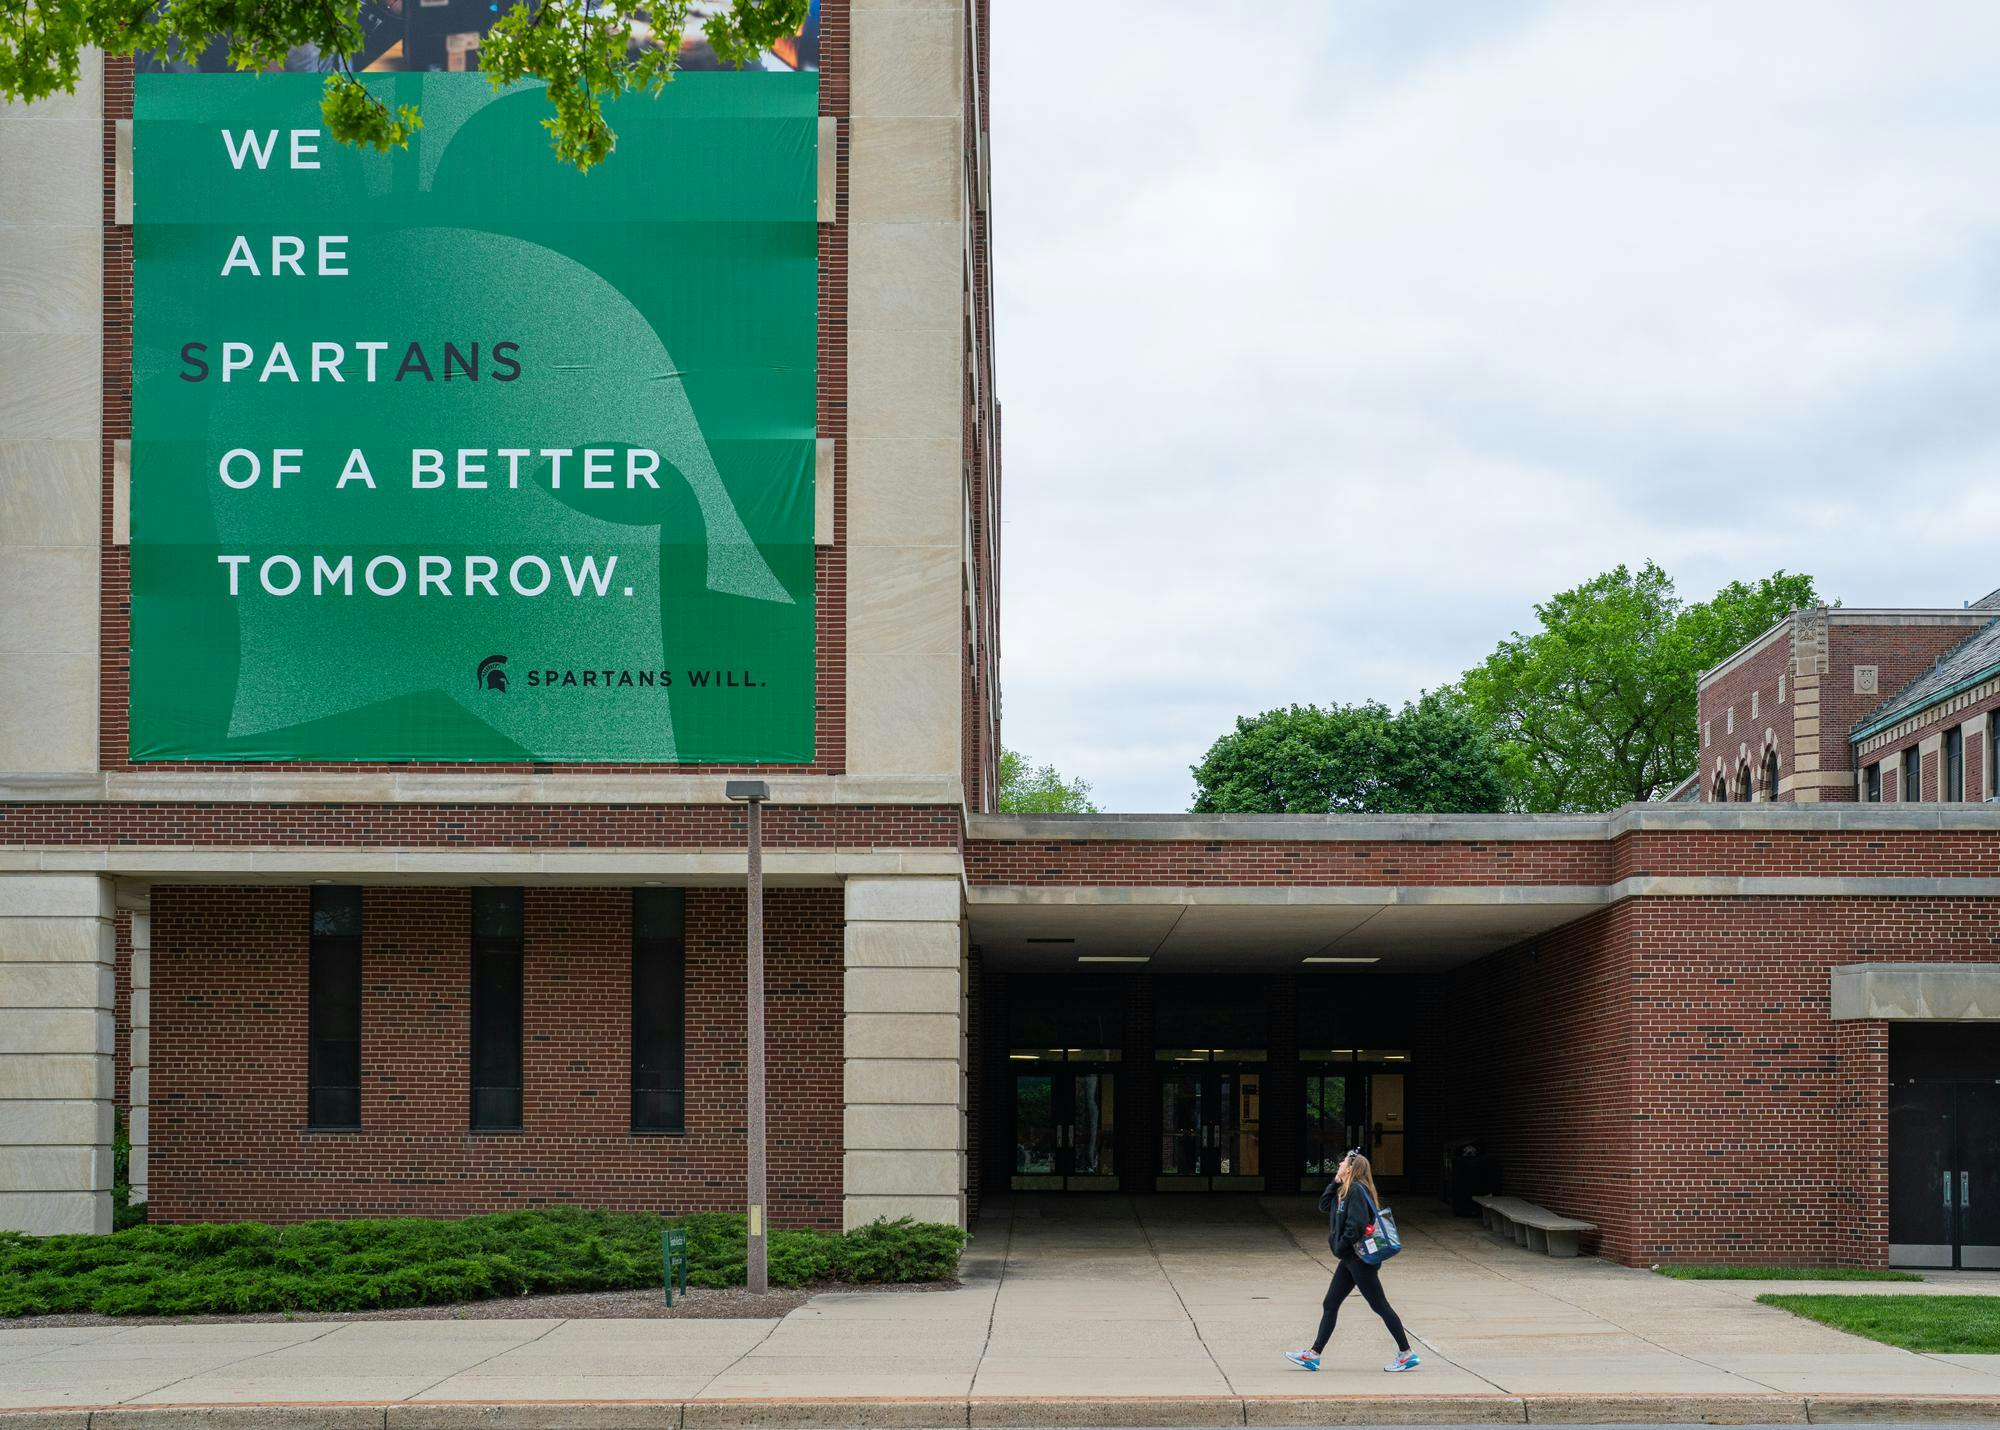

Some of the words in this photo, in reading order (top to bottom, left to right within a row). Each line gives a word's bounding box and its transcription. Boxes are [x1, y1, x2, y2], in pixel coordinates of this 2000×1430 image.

[221, 129, 322, 171] WE
[221, 235, 350, 277] ARE
[179, 341, 522, 384] SPARTANS
[219, 448, 304, 490] OF
[336, 448, 377, 490] A
[411, 448, 661, 490] BETTER
[217, 554, 634, 597] TOMORROW.
[527, 669, 673, 688] SPARTANS
[687, 669, 767, 688] WILL.
